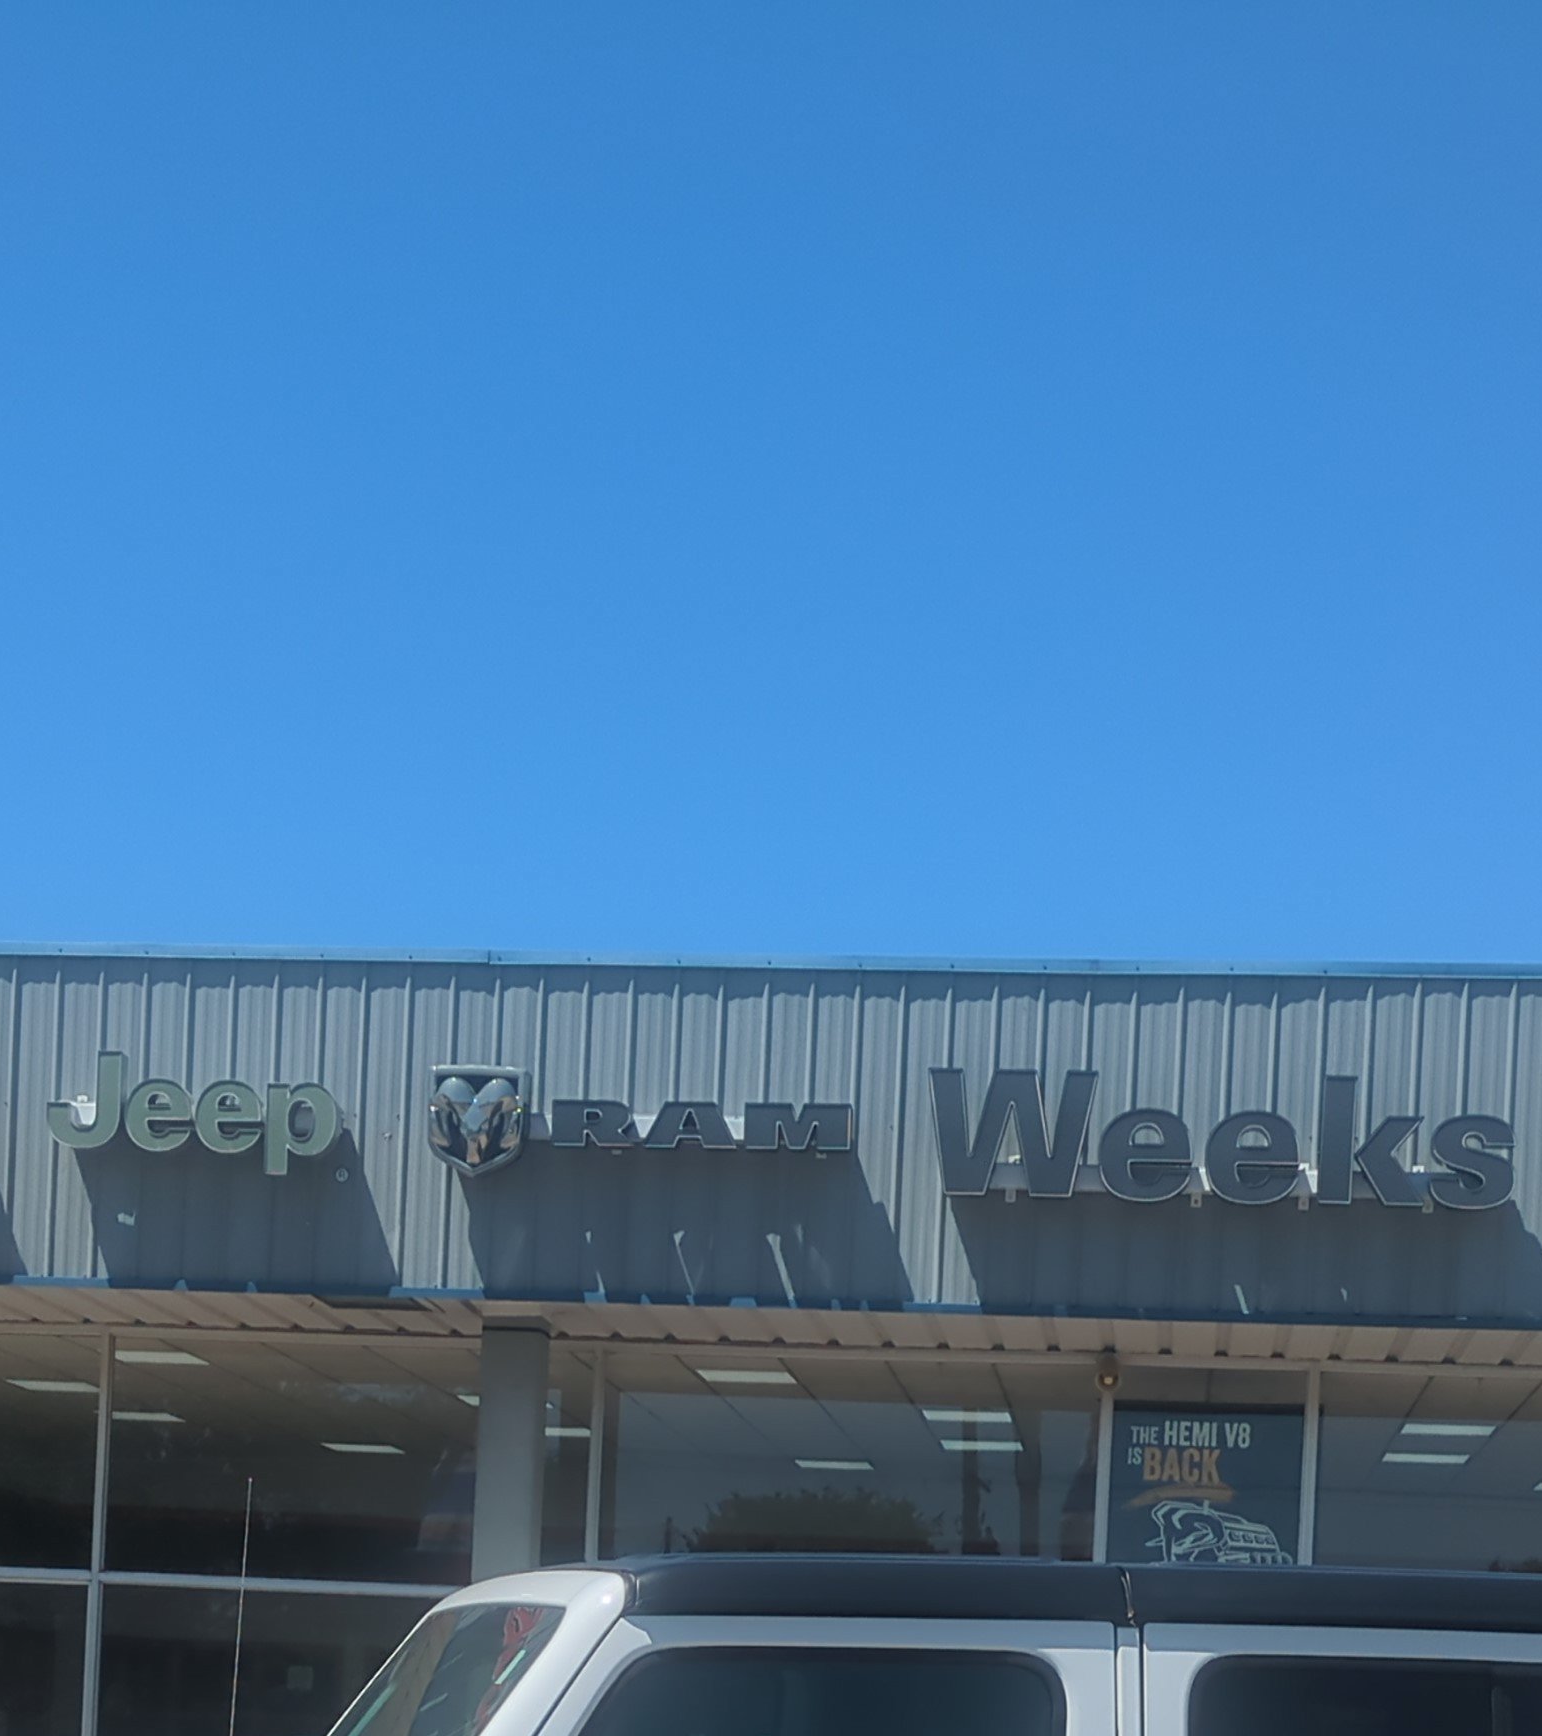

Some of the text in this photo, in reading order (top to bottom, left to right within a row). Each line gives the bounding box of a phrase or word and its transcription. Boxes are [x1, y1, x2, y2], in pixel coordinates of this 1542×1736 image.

[47, 1051, 339, 1175] Jeep
[552, 1098, 853, 1150] RAM
[929, 1068, 1516, 1210] Weeks
[1131, 1420, 1252, 1448] THE HEMI V8
[1127, 1447, 1221, 1484] IS BACK
